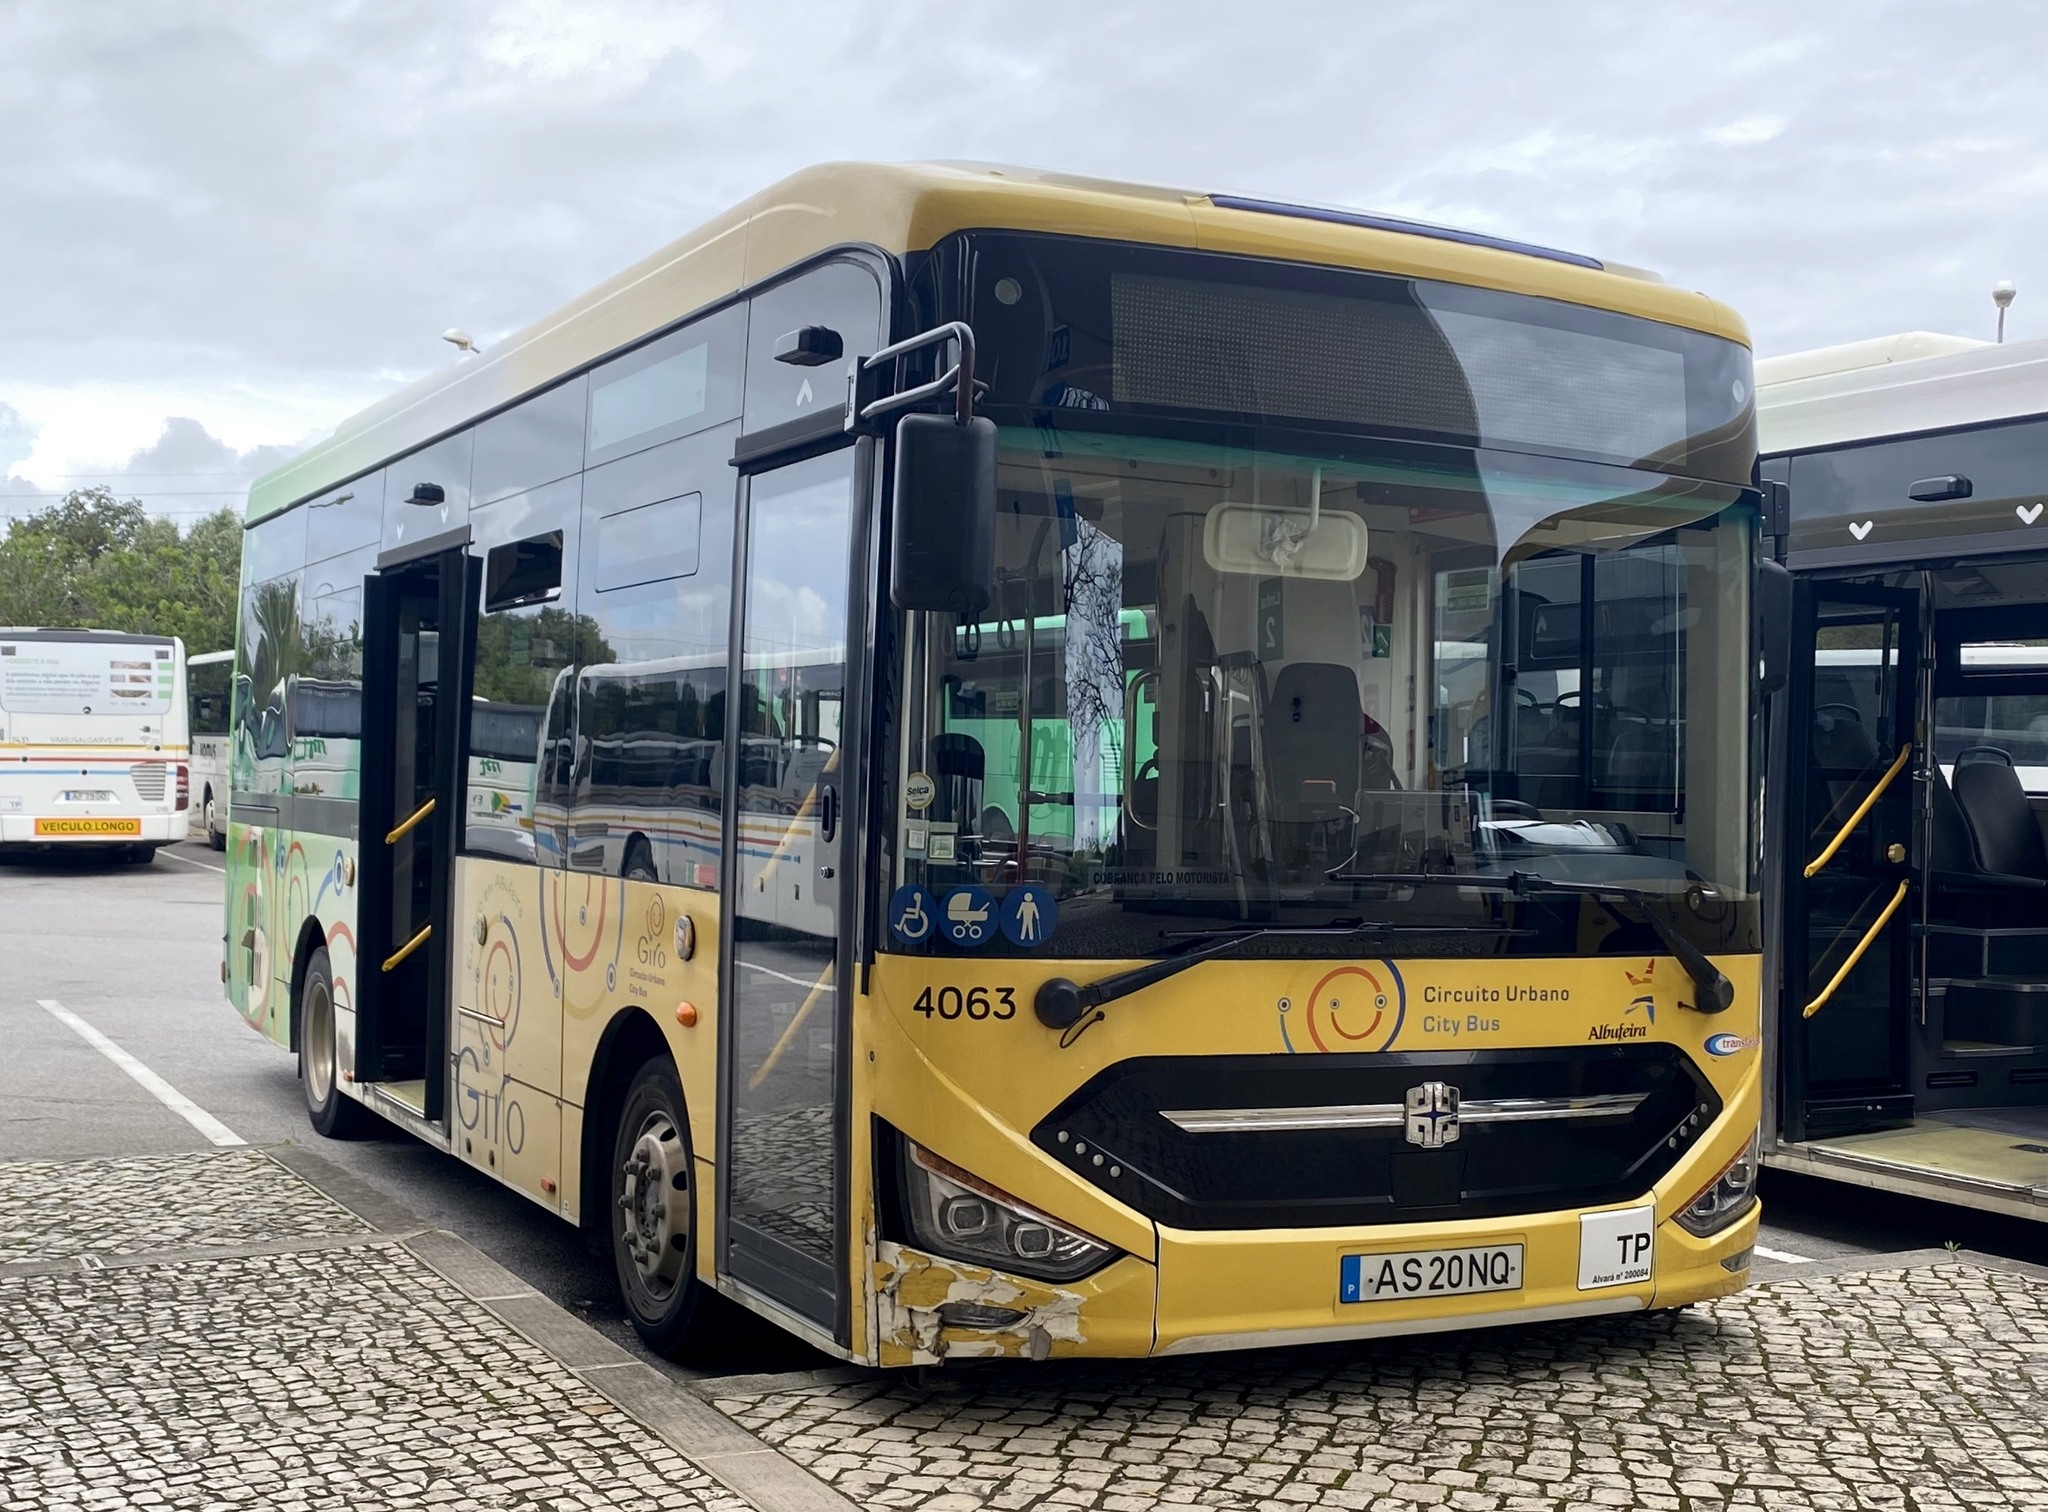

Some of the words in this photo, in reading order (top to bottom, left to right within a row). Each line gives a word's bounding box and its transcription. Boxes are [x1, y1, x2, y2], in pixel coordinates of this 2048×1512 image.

[95, 822, 134, 831] LONGO
[1093, 871, 1147, 886] COBRANÇA
[1150, 872, 1173, 884] PELO
[1176, 872, 1230, 884] MOTORISTA
[637, 935, 666, 969] Giro
[913, 986, 1016, 1020] 4063
[1423, 986, 1500, 1003] Circuito
[1506, 985, 1570, 1002] Urbano
[1423, 1015, 1460, 1036] City
[1466, 1015, 1500, 1032] Bus
[1588, 1023, 1647, 1041] Albufeira
[456, 1046, 525, 1155] Giro
[1616, 1232, 1651, 1265] TP
[1592, 1272, 1615, 1284] Alvará
[1624, 1267, 1649, 1279] 200084
[1347, 1284, 1356, 1295] P
